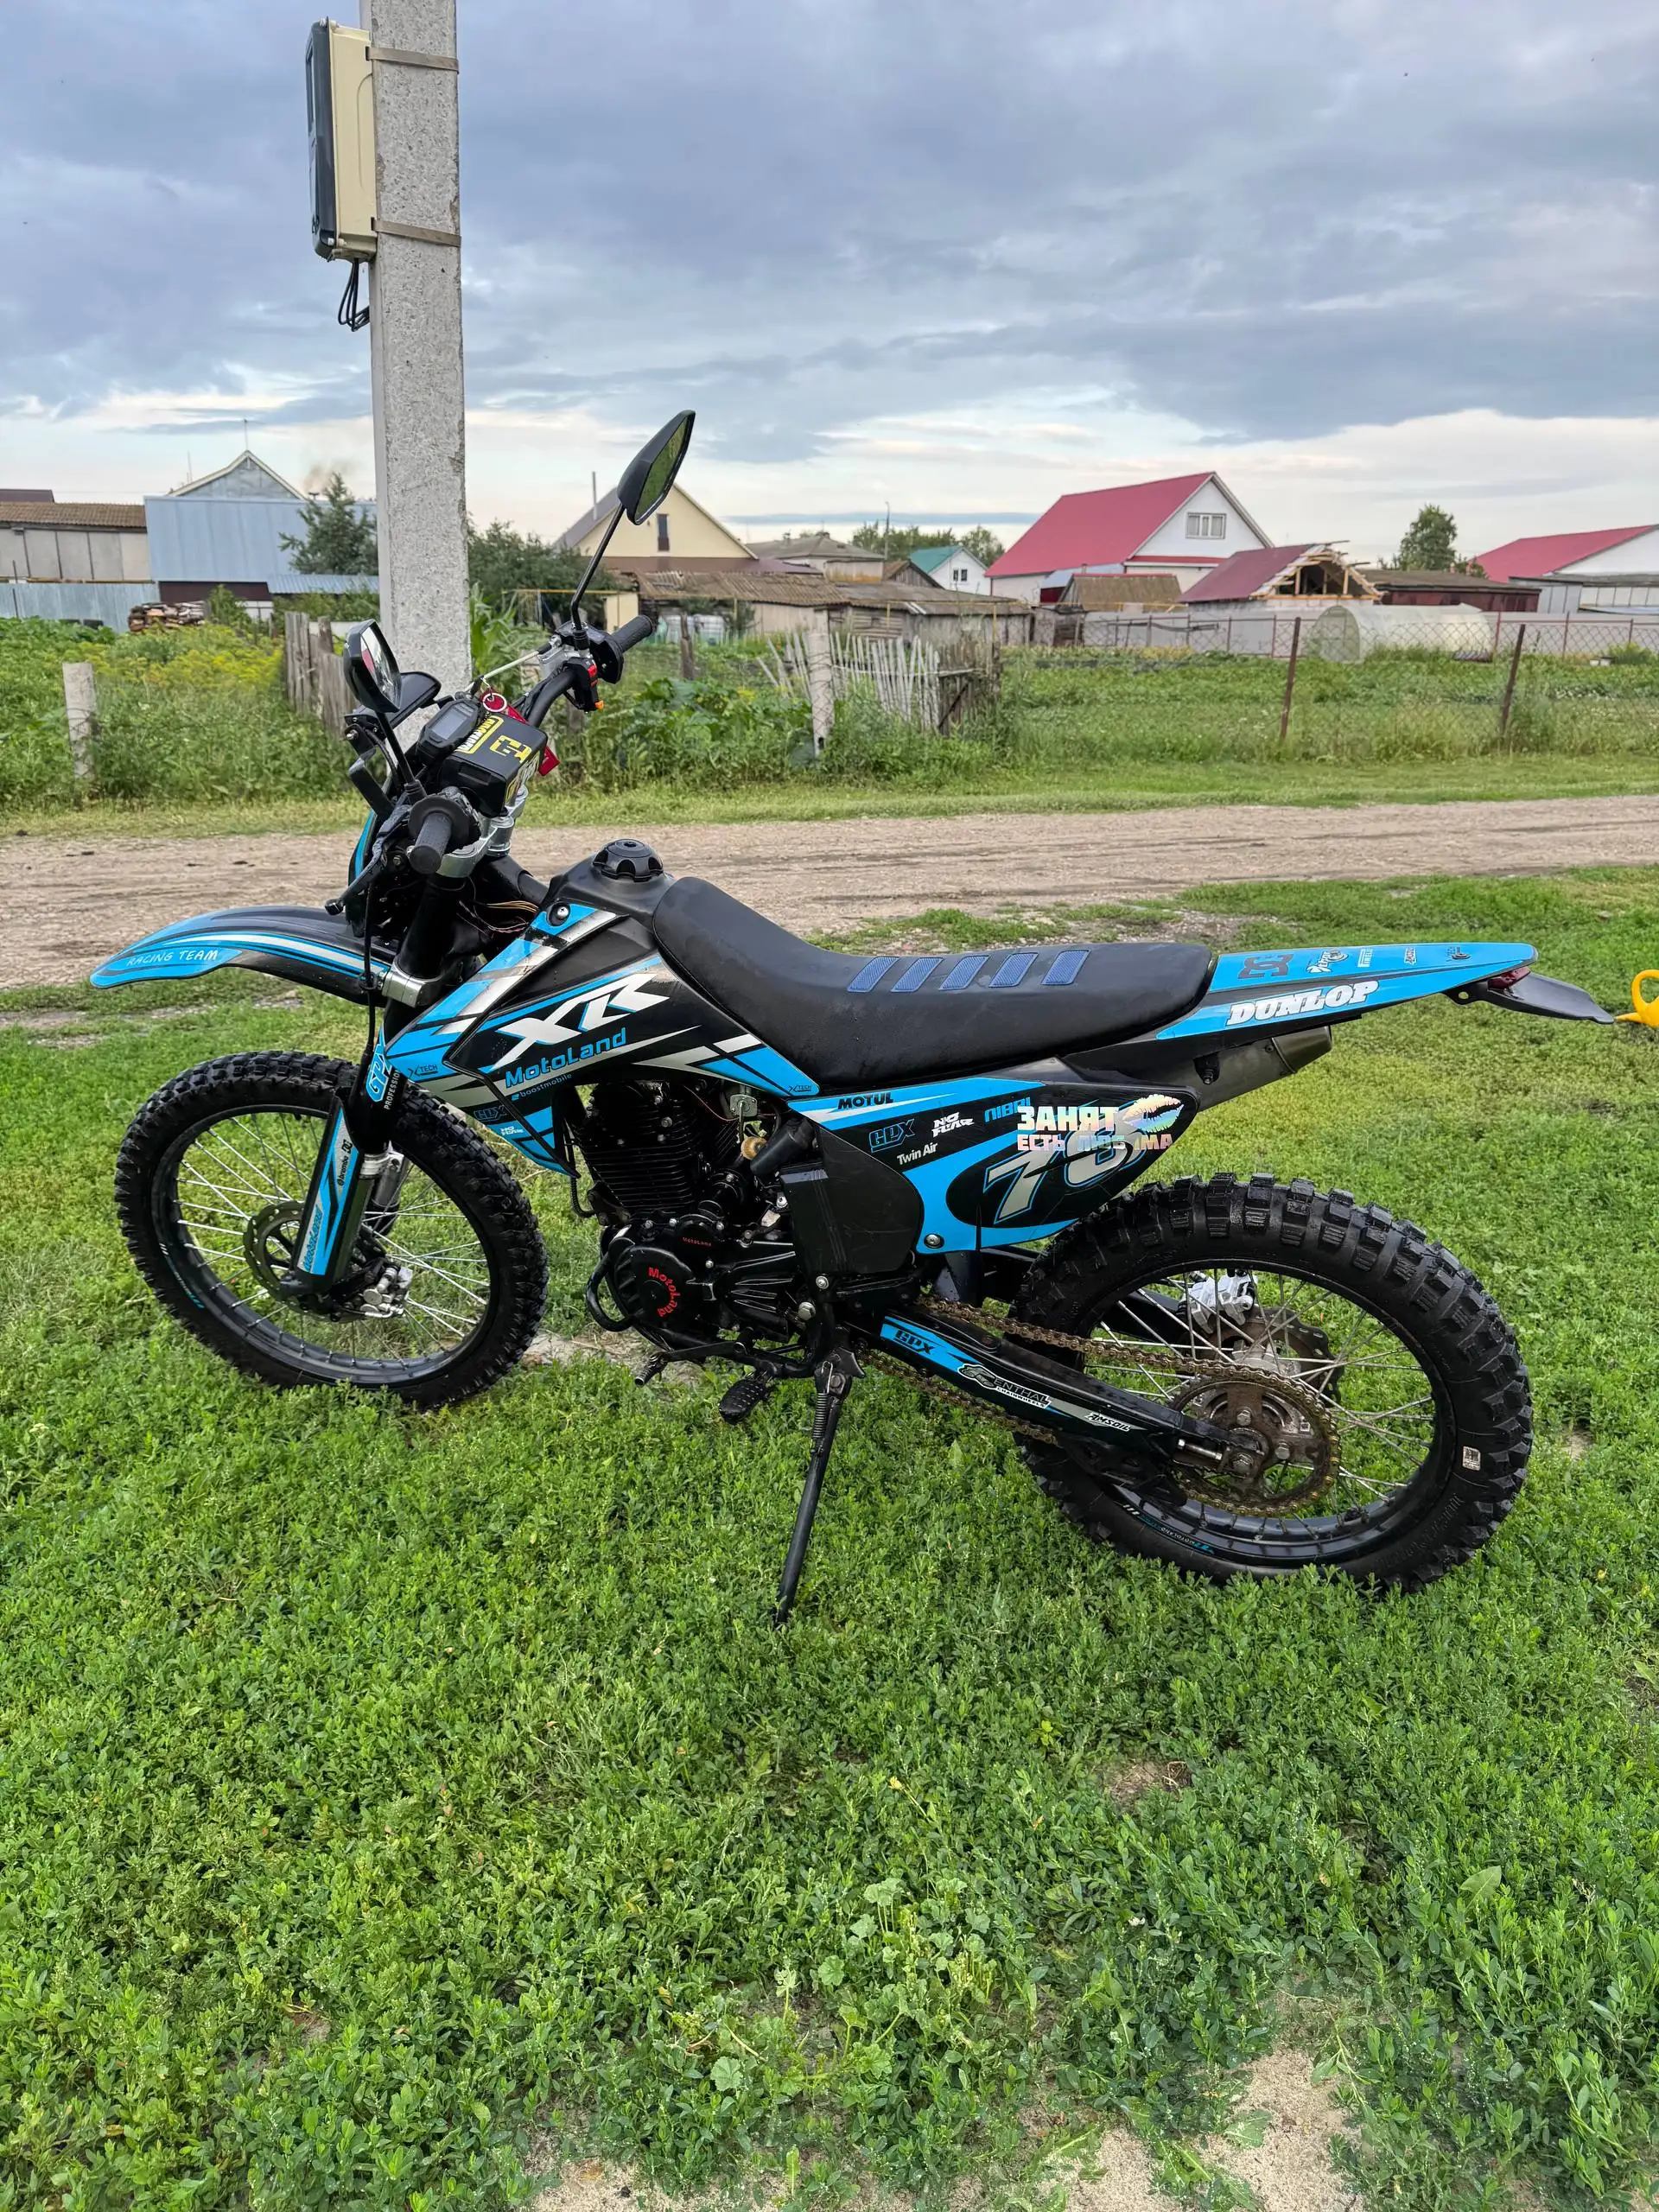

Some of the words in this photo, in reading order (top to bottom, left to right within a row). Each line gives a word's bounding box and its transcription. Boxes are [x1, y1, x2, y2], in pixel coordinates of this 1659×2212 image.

[127, 951, 174, 966] RACING
[179, 950, 219, 962] TEAM
[1225, 980, 1380, 1027] DUNLOP
[505, 1027, 627, 1089] MotoLand
[384, 1069, 401, 1110] PROFESSIO
[520, 1072, 572, 1098] boostmobile
[837, 1091, 893, 1110] MOTUL
[933, 1111, 960, 1128] NO
[1017, 1106, 1117, 1131] ЗАНЯТ
[897, 1147, 922, 1166] Twin
[923, 1141, 938, 1157] Air
[1017, 1134, 1065, 1151] ЕСТЬ
[1086, 1411, 1129, 1432] AMSOIL
